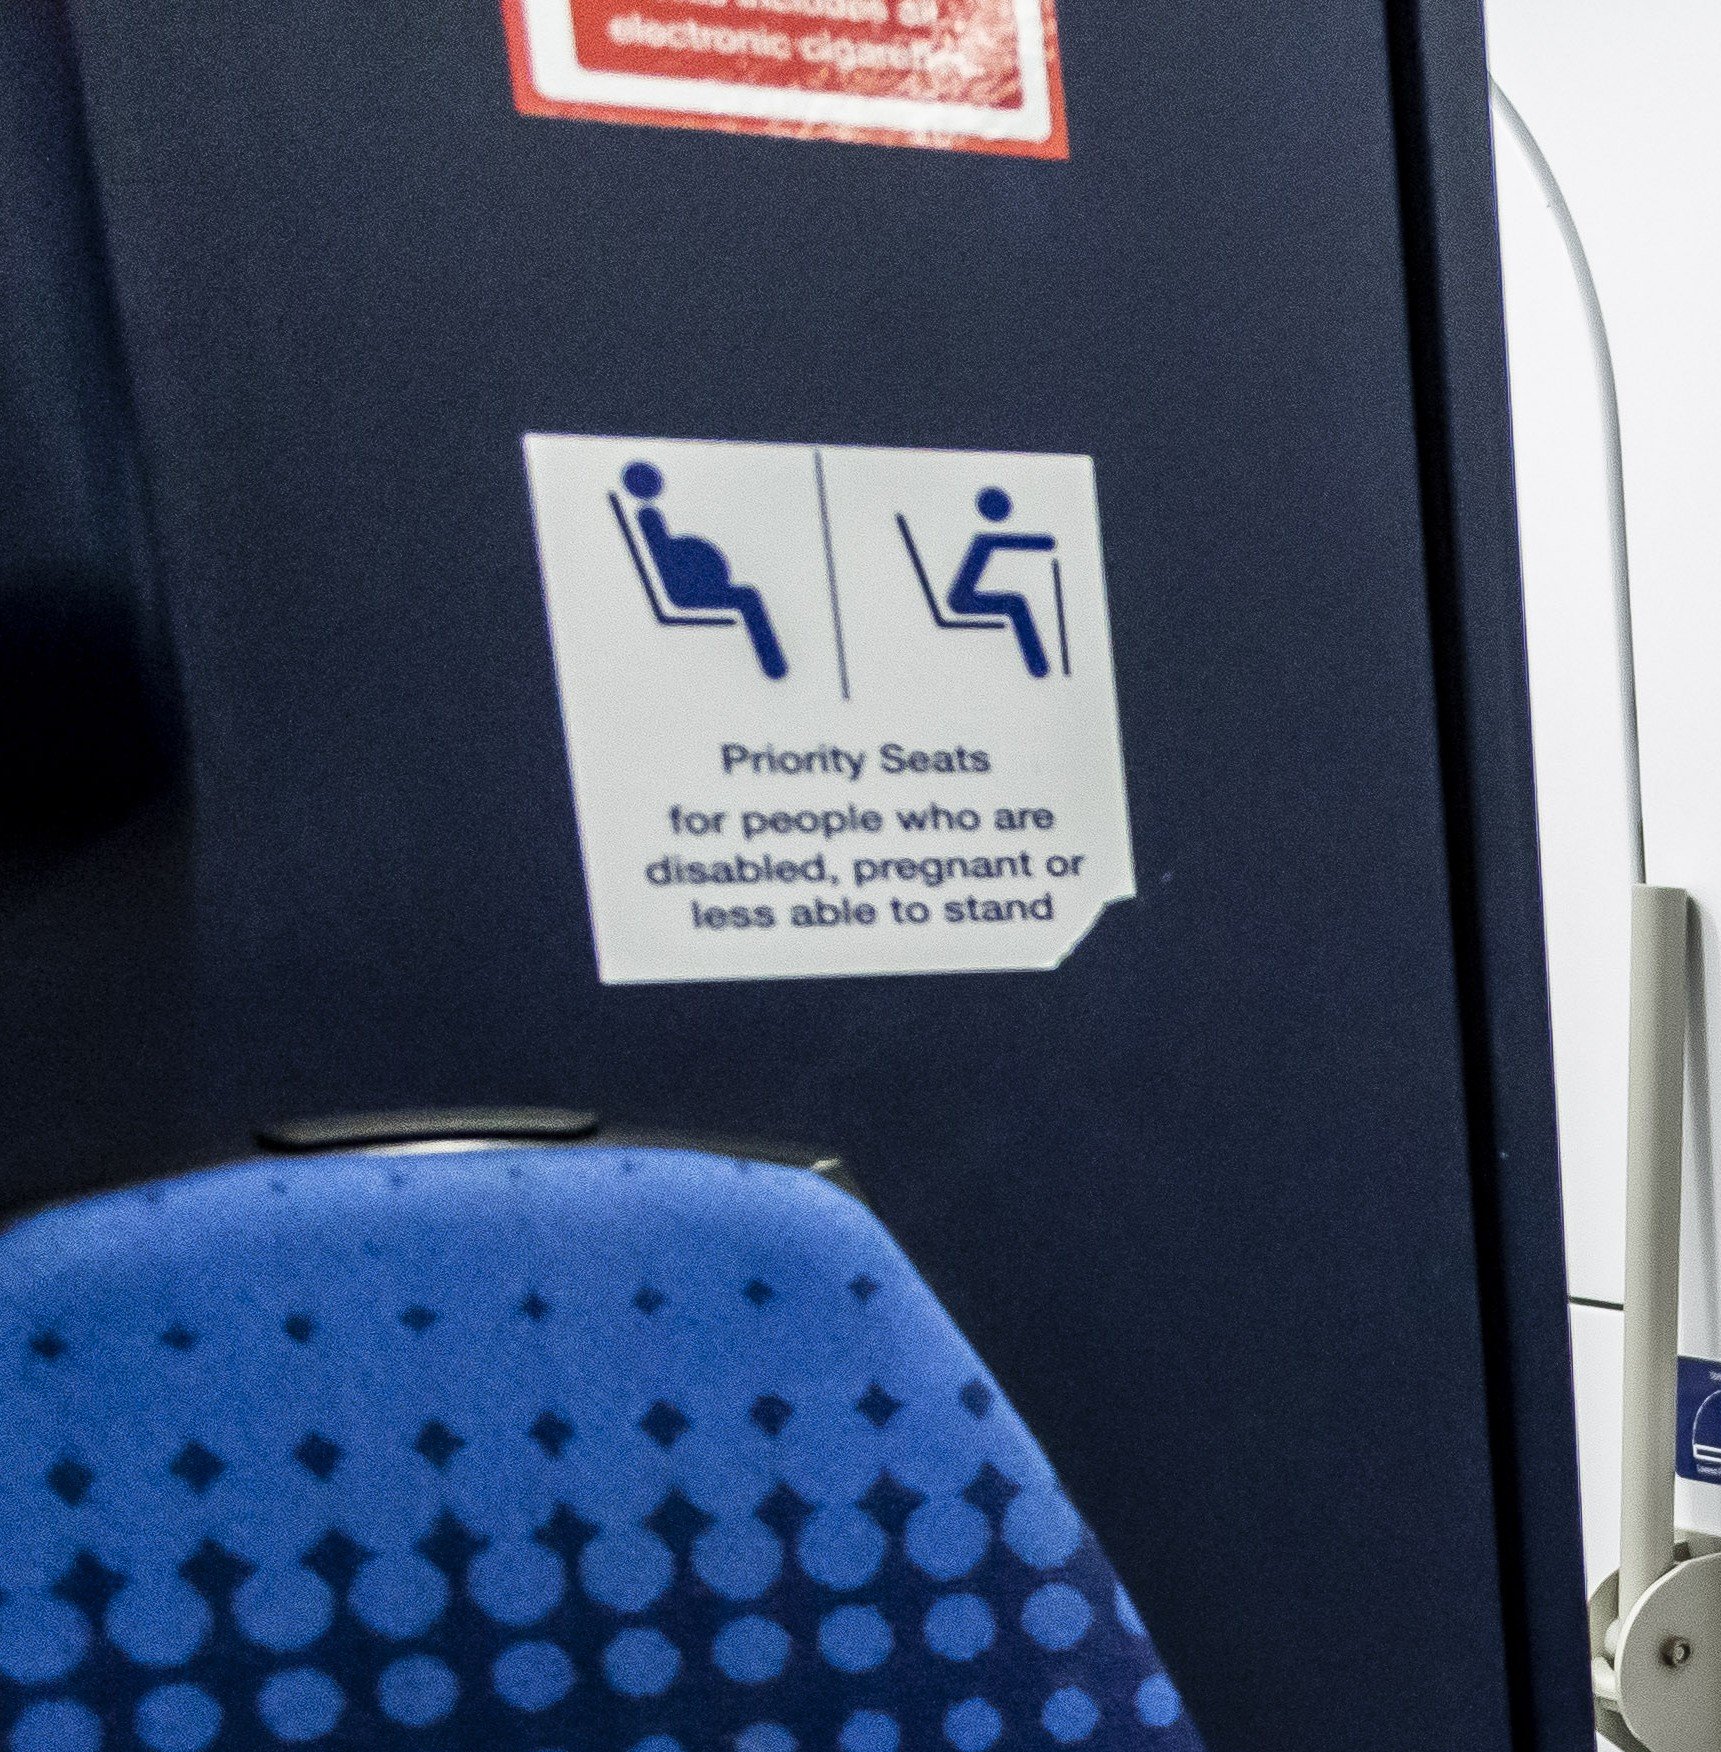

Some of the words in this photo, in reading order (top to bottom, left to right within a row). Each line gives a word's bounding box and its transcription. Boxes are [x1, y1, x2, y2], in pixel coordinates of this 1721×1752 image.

[721, 742, 866, 781] Priority
[879, 742, 992, 774] Seats
[668, 804, 726, 835] for
[741, 804, 883, 841] people
[896, 802, 981, 832] who
[994, 806, 1055, 832] are
[645, 853, 838, 886] disabled,
[853, 850, 1032, 887] pregnant
[1045, 854, 1085, 878] or
[691, 900, 776, 930] less
[790, 896, 877, 927] able
[890, 897, 931, 925] to
[943, 892, 1055, 925] stand
